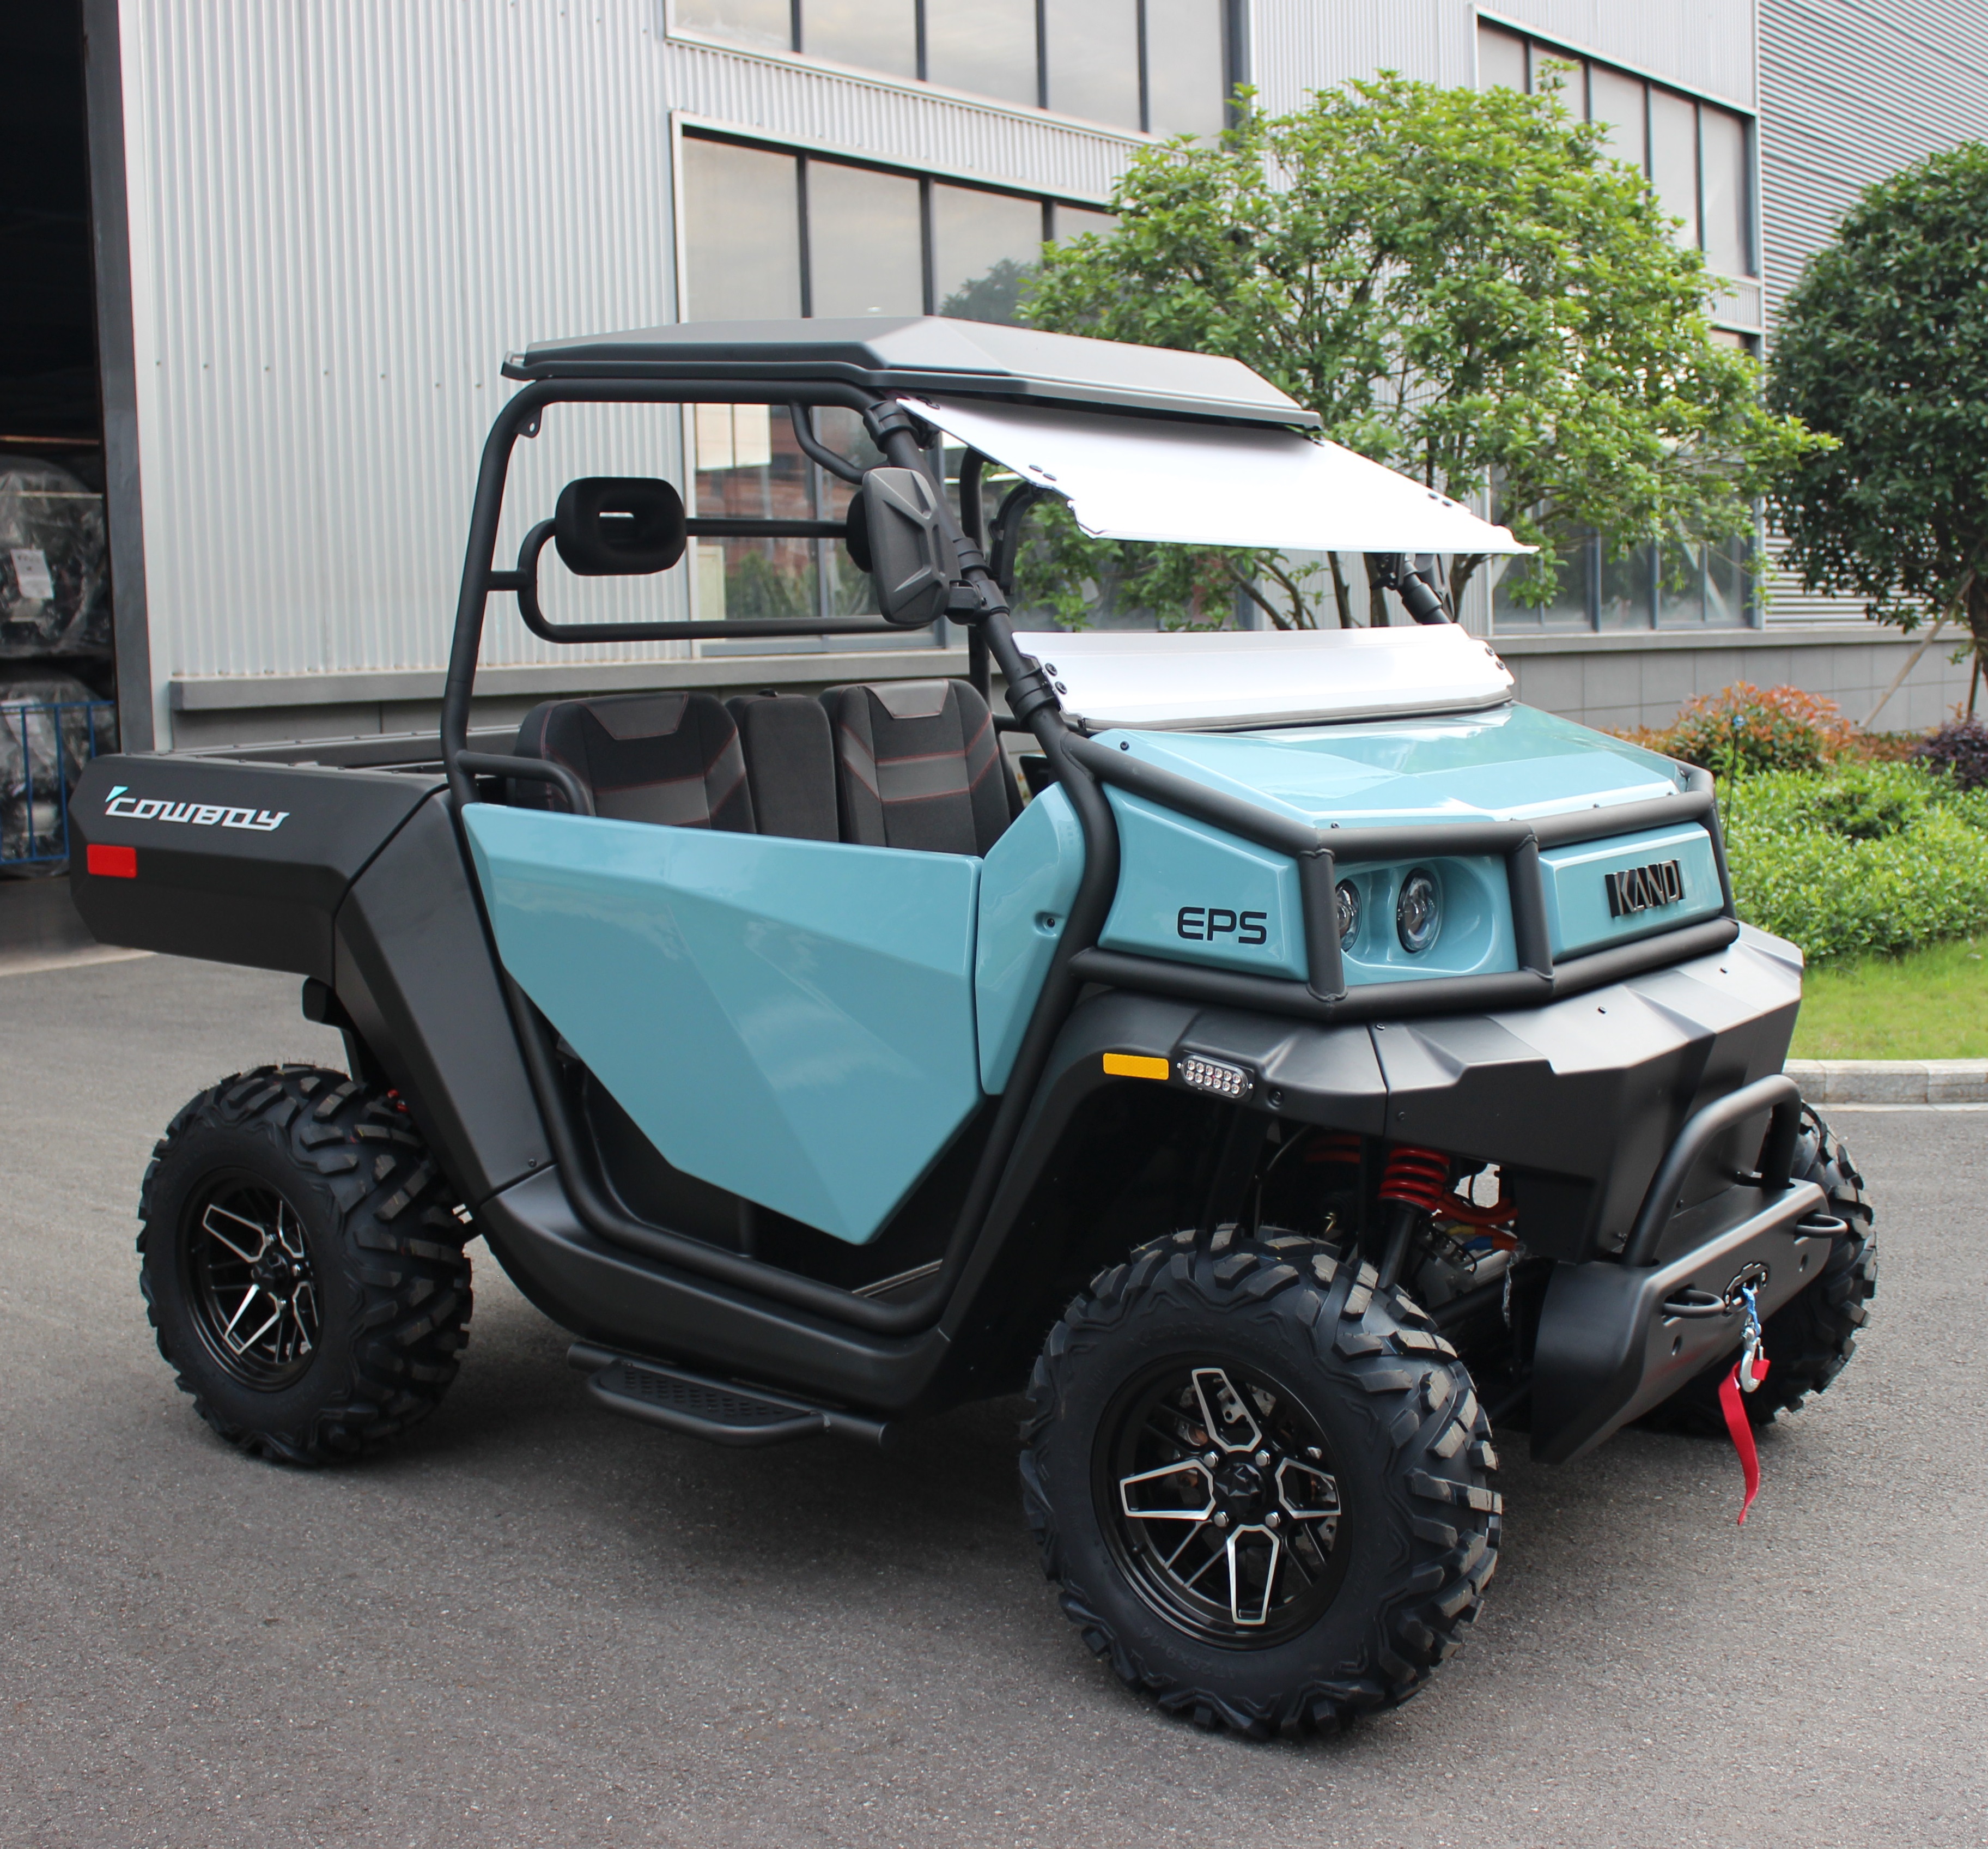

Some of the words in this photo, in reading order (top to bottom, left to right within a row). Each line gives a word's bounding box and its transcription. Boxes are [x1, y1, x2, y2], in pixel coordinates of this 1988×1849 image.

[105, 797, 290, 832] COWBOY
[1605, 859, 1686, 917] KANDI
[1177, 906, 1267, 945] EPS
